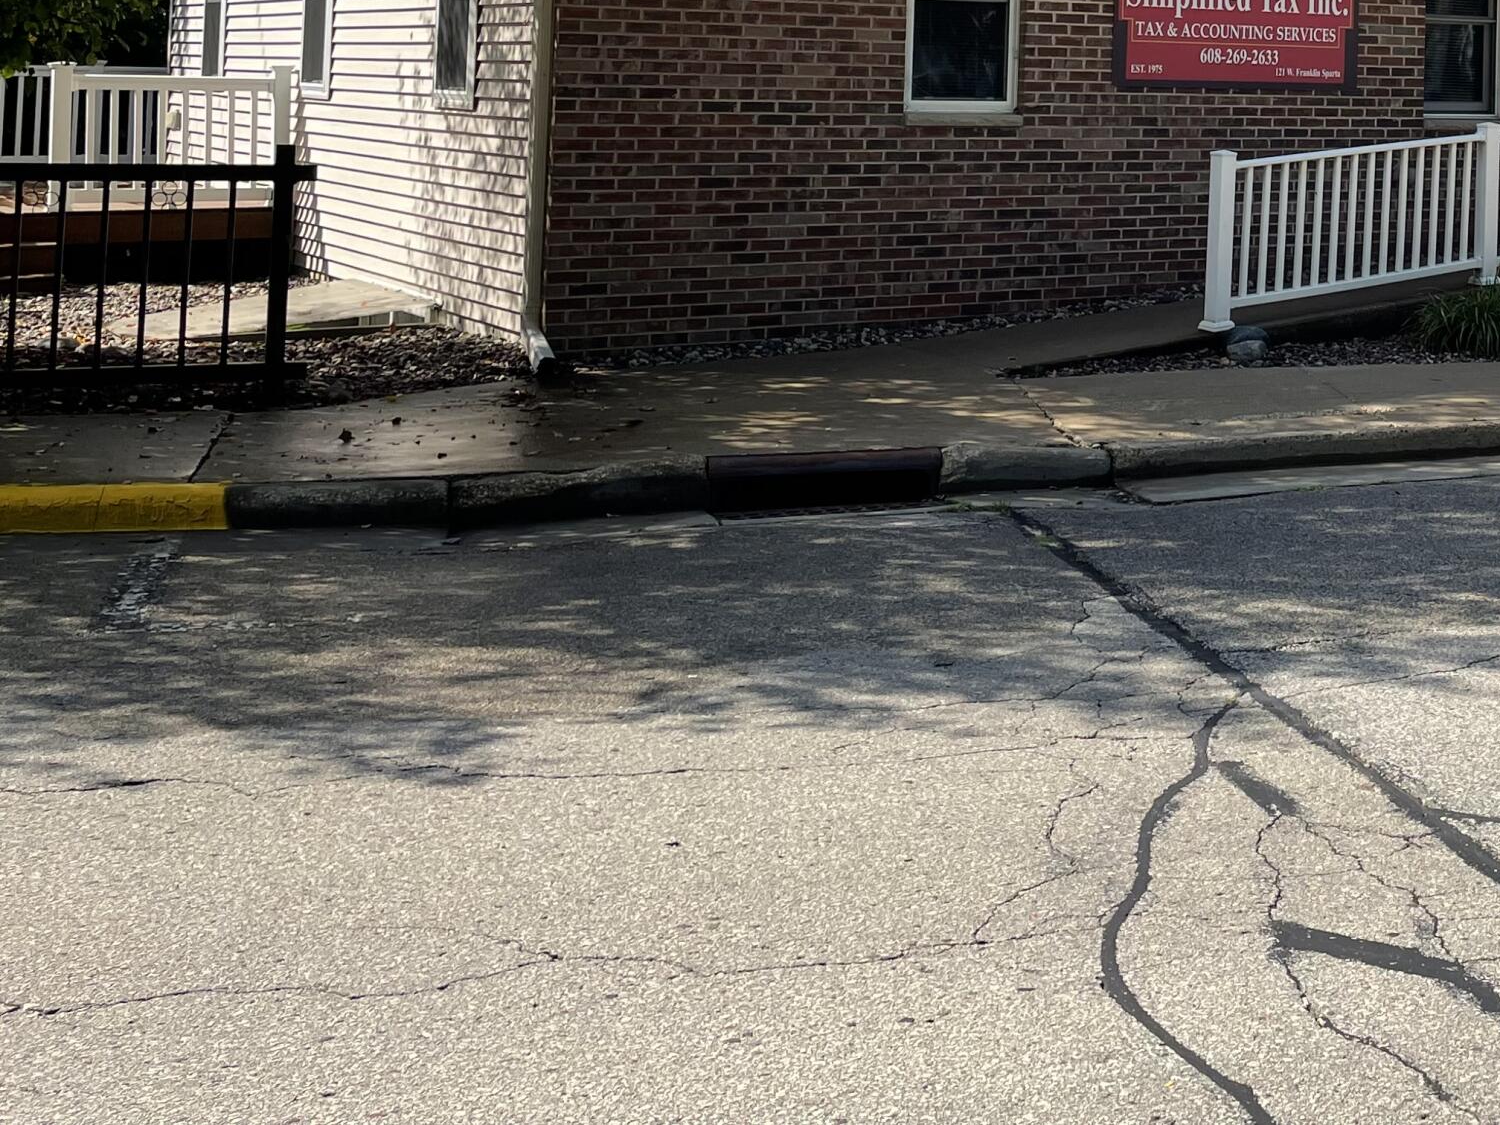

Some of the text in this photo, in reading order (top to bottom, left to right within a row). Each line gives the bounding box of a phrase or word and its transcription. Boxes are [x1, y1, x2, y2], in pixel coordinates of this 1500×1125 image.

[1135, 21, 1337, 43] TAX & ACCOUNTING SERVICES
[1199, 48, 1279, 65] 608-269-2633
[1130, 64, 1163, 74] EST. 1975
[1275, 68, 1285, 77] 121
[1296, 68, 1321, 78] Franklin
[1321, 69, 1341, 79] Sparta
